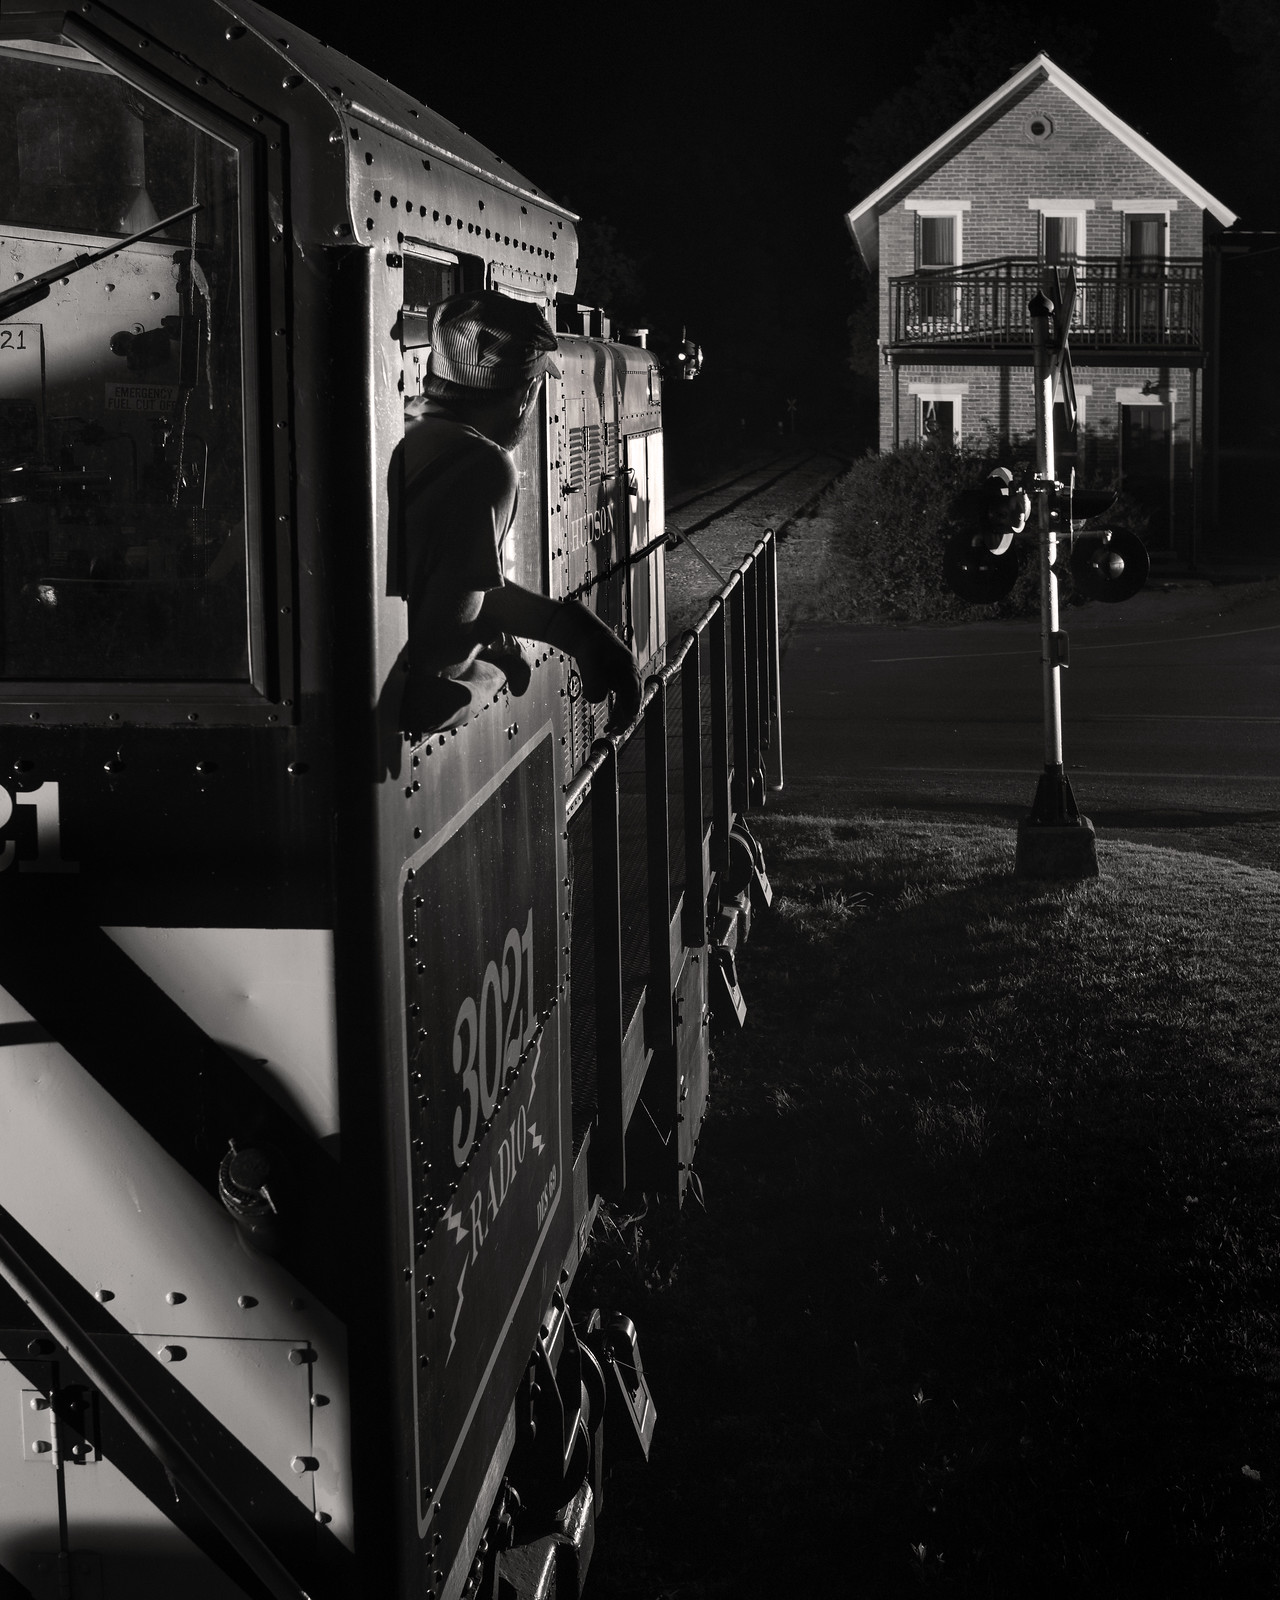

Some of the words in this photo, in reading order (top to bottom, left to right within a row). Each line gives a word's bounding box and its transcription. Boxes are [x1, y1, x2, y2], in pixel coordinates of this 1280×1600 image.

[0, 330, 26, 350] 21
[108, 398, 131, 410] FUEL
[136, 399, 156, 410] CUT
[115, 386, 173, 400] EMERGENCY
[571, 502, 614, 552] HUDSON
[453, 907, 537, 1168] 3021
[471, 1104, 527, 1266] RADIO
